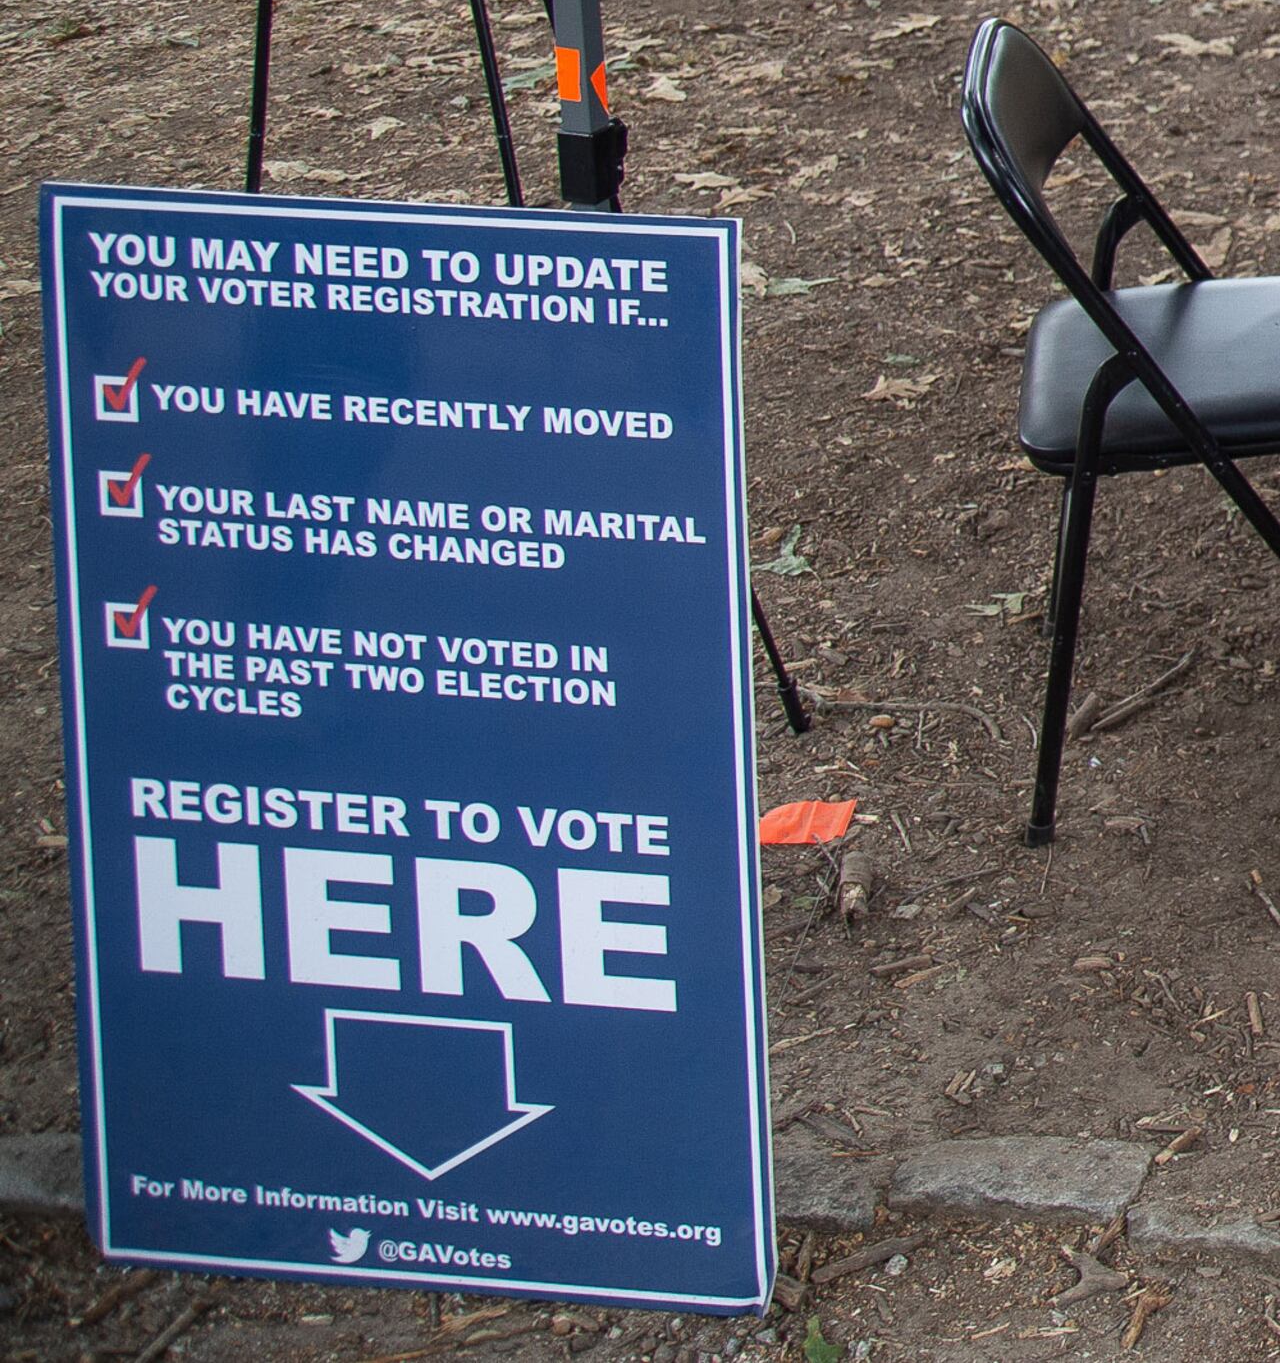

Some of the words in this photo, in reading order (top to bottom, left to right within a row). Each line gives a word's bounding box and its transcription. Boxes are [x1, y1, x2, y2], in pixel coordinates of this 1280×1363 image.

[89, 232, 174, 269] YOU
[191, 238, 279, 272] MAY
[295, 244, 408, 279] NEED
[422, 250, 479, 283] TO
[496, 254, 667, 292] UPDATE
[91, 271, 188, 301] YOUR
[198, 277, 316, 308] VOTER
[328, 284, 594, 323] REGISTRATION
[608, 299, 668, 326] IF...
[151, 384, 224, 413] YOU
[237, 390, 331, 419] HAVE
[344, 396, 531, 431] RECENTLY
[544, 408, 672, 439] MOVED
[156, 485, 254, 516] YOUR
[266, 492, 354, 522] LAST
[367, 499, 469, 529] NAME
[481, 506, 532, 533] OR
[545, 509, 705, 543] MARITAL
[159, 519, 292, 551] STATUS
[305, 528, 376, 557] HAS
[389, 533, 564, 568] CHANGED
[162, 618, 234, 647] YOU
[248, 624, 342, 654] HAVE
[354, 631, 426, 660] NOT
[438, 637, 557, 668] VOTED
[571, 646, 607, 672] IN
[164, 651, 234, 680] THE
[246, 657, 333, 686] PAST
[344, 664, 423, 693] TWO
[437, 670, 615, 706] ELECTION
[166, 684, 301, 717] CYCLES
[131, 778, 409, 836] REGISTER
[425, 800, 499, 843] TO
[517, 807, 669, 855] VOTE
[135, 835, 676, 1012] HERE
[133, 1175, 174, 1196] For
[182, 1180, 246, 1203] More
[256, 1186, 408, 1216] Information
[417, 1199, 478, 1222] Visit
[486, 1209, 721, 1246] www.gavotes.org
[379, 1240, 511, 1269] @GAVotes
